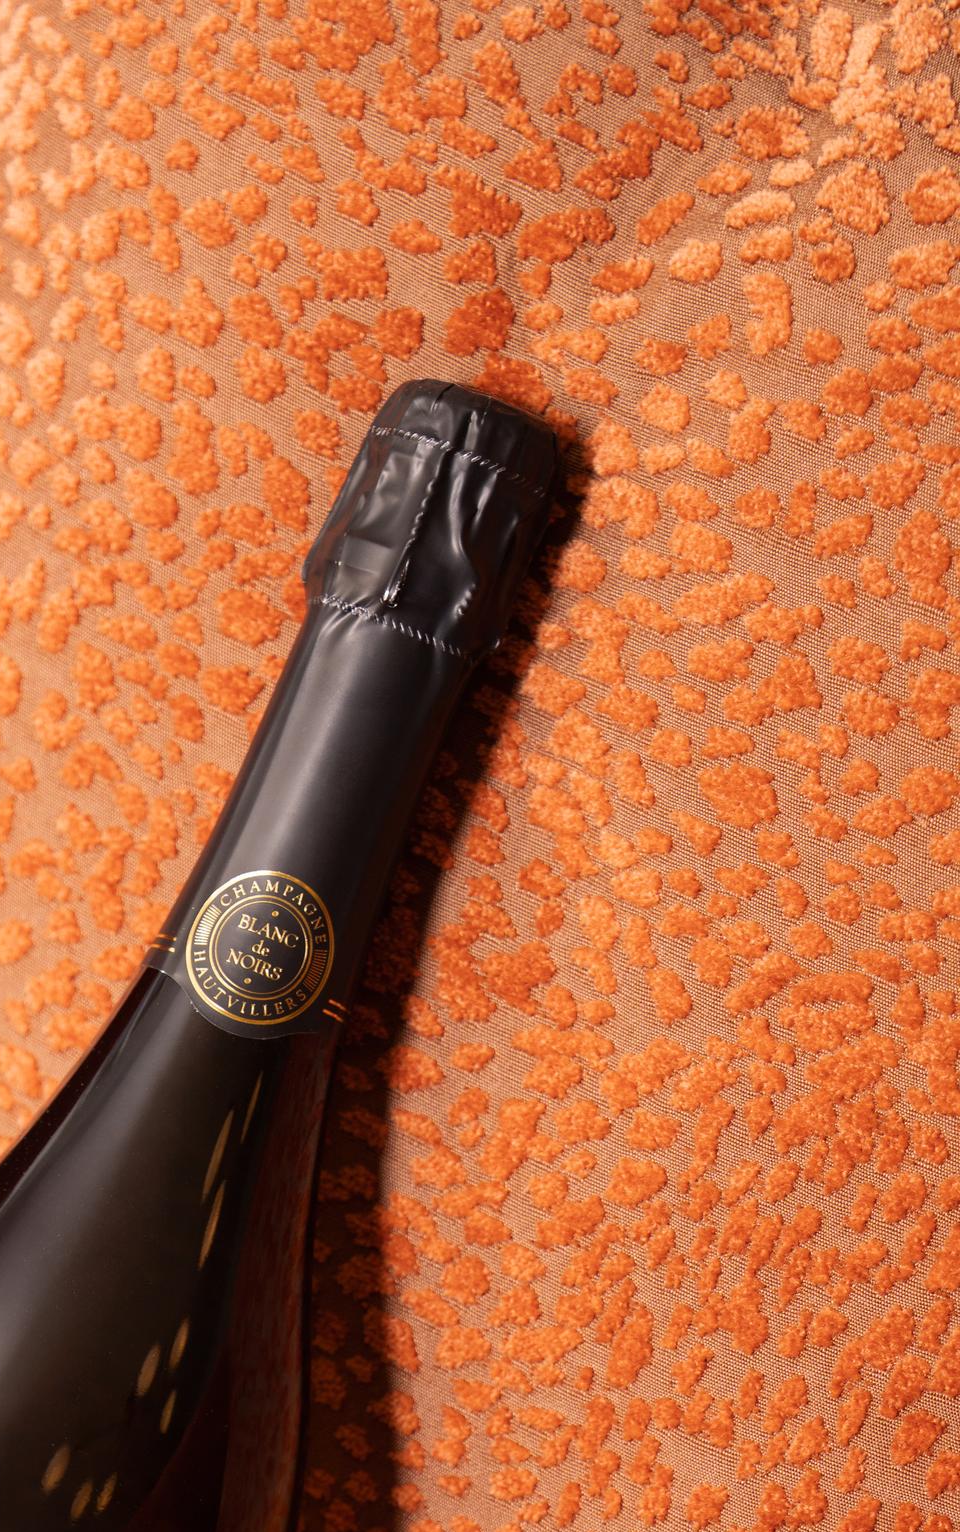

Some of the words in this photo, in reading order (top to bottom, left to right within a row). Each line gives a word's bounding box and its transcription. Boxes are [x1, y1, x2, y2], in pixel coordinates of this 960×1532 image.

[220, 879, 327, 944] CHAMPAGNE
[238, 914, 299, 948] BLANC
[251, 939, 270, 957] de
[226, 948, 283, 981] NOIRS
[193, 950, 307, 1017] HAUTVILLERS
